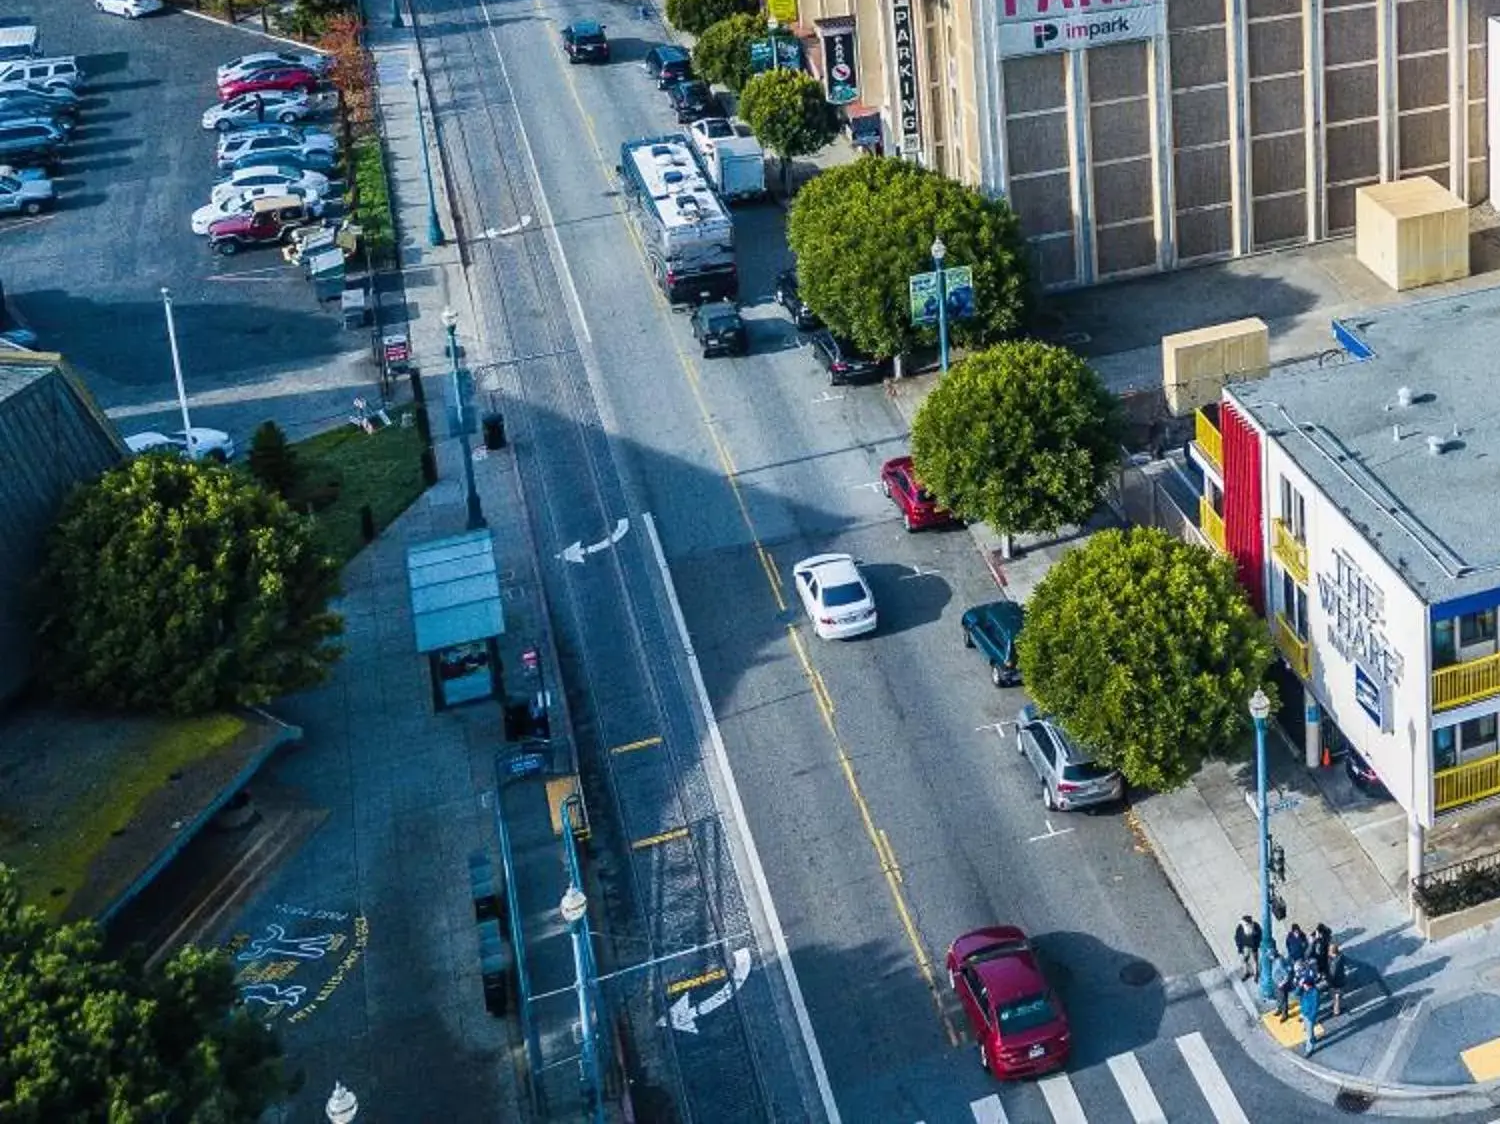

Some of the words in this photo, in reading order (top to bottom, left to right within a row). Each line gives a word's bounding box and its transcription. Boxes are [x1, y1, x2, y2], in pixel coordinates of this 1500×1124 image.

[895, 11, 917, 130] PARKING
[1066, 15, 1131, 40] impark
[1317, 572, 1404, 687] WHARF
[1332, 548, 1384, 624] THE
